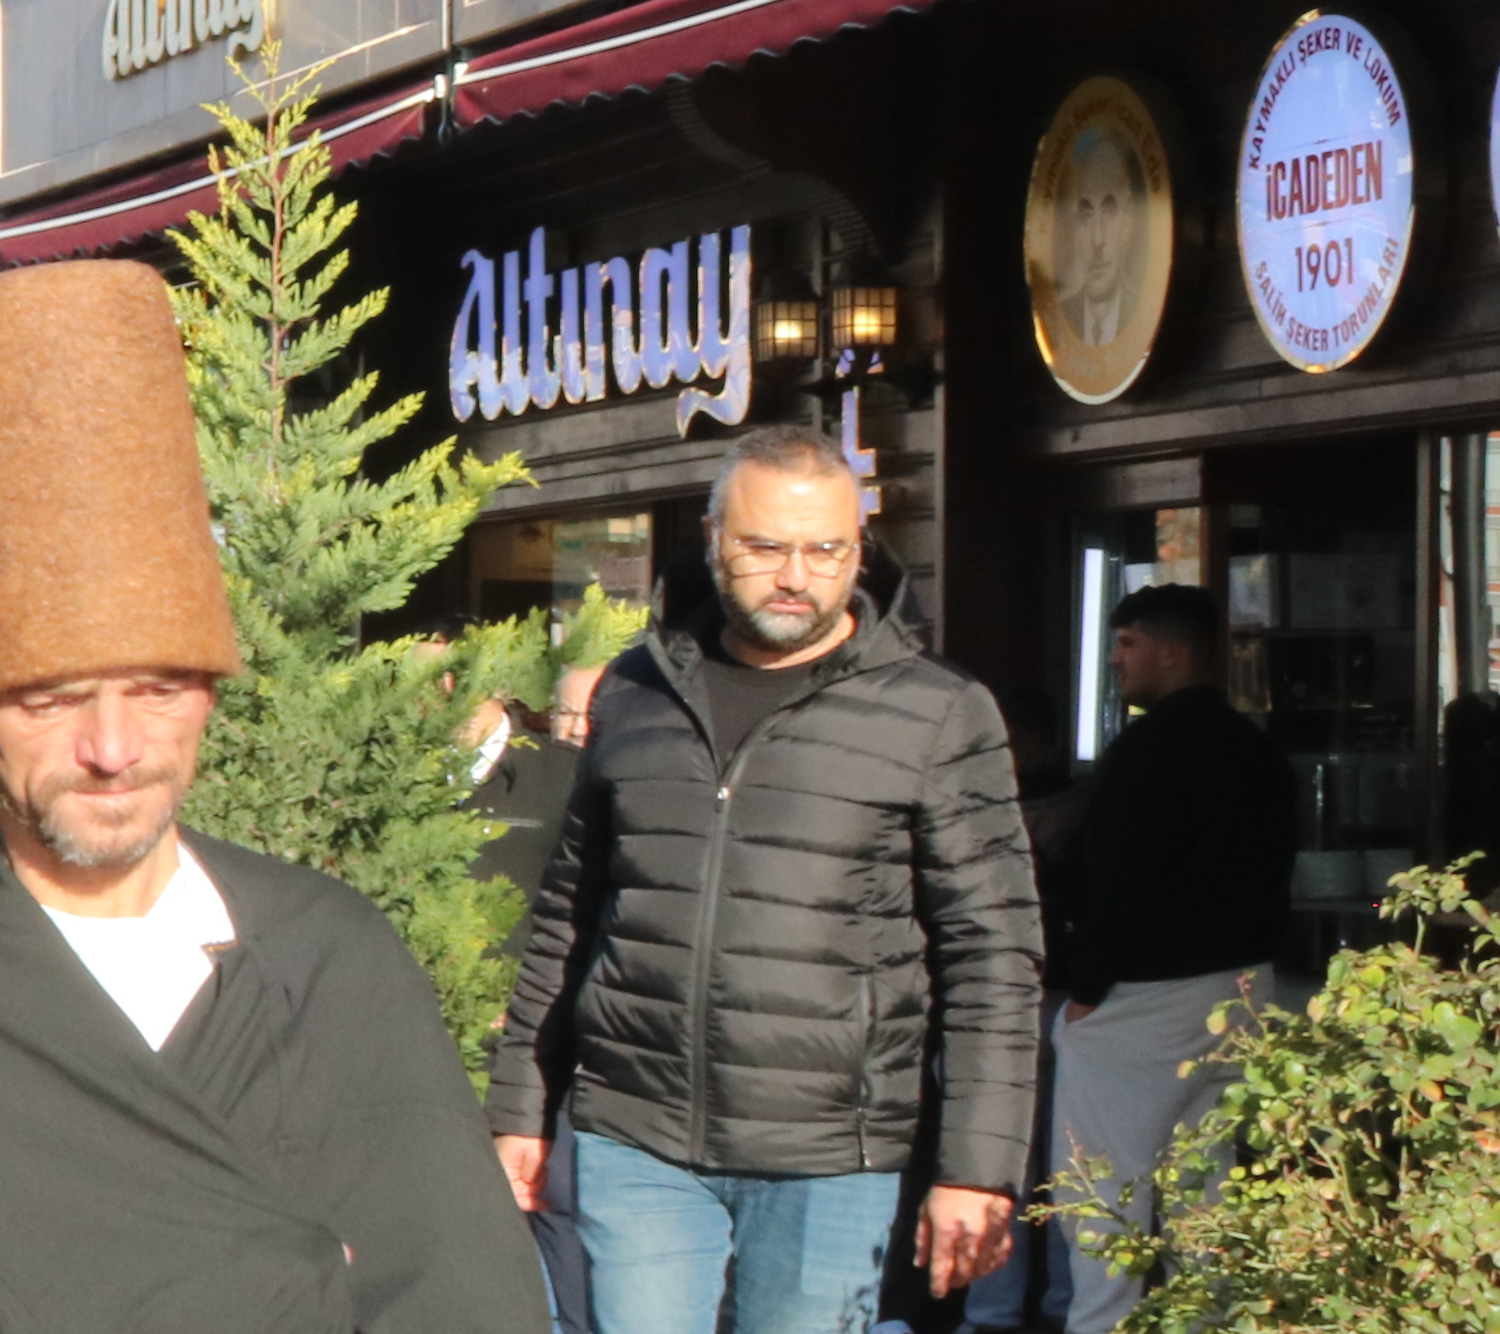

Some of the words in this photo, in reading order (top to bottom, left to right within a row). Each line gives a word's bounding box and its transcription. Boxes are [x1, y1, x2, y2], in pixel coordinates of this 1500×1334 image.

[1248, 50, 1297, 170] KAYMAKLI
[1298, 26, 1341, 64] ŞEKER
[1346, 30, 1364, 60] VE
[1364, 47, 1402, 127] LOKUM
[1265, 139, 1384, 223] İCADEDEN
[1255, 260, 1286, 327] SALİH
[1286, 318, 1329, 352] ŞEKER
[1331, 237, 1399, 344] TORUNLARI
[1294, 236, 1355, 293] 1901
